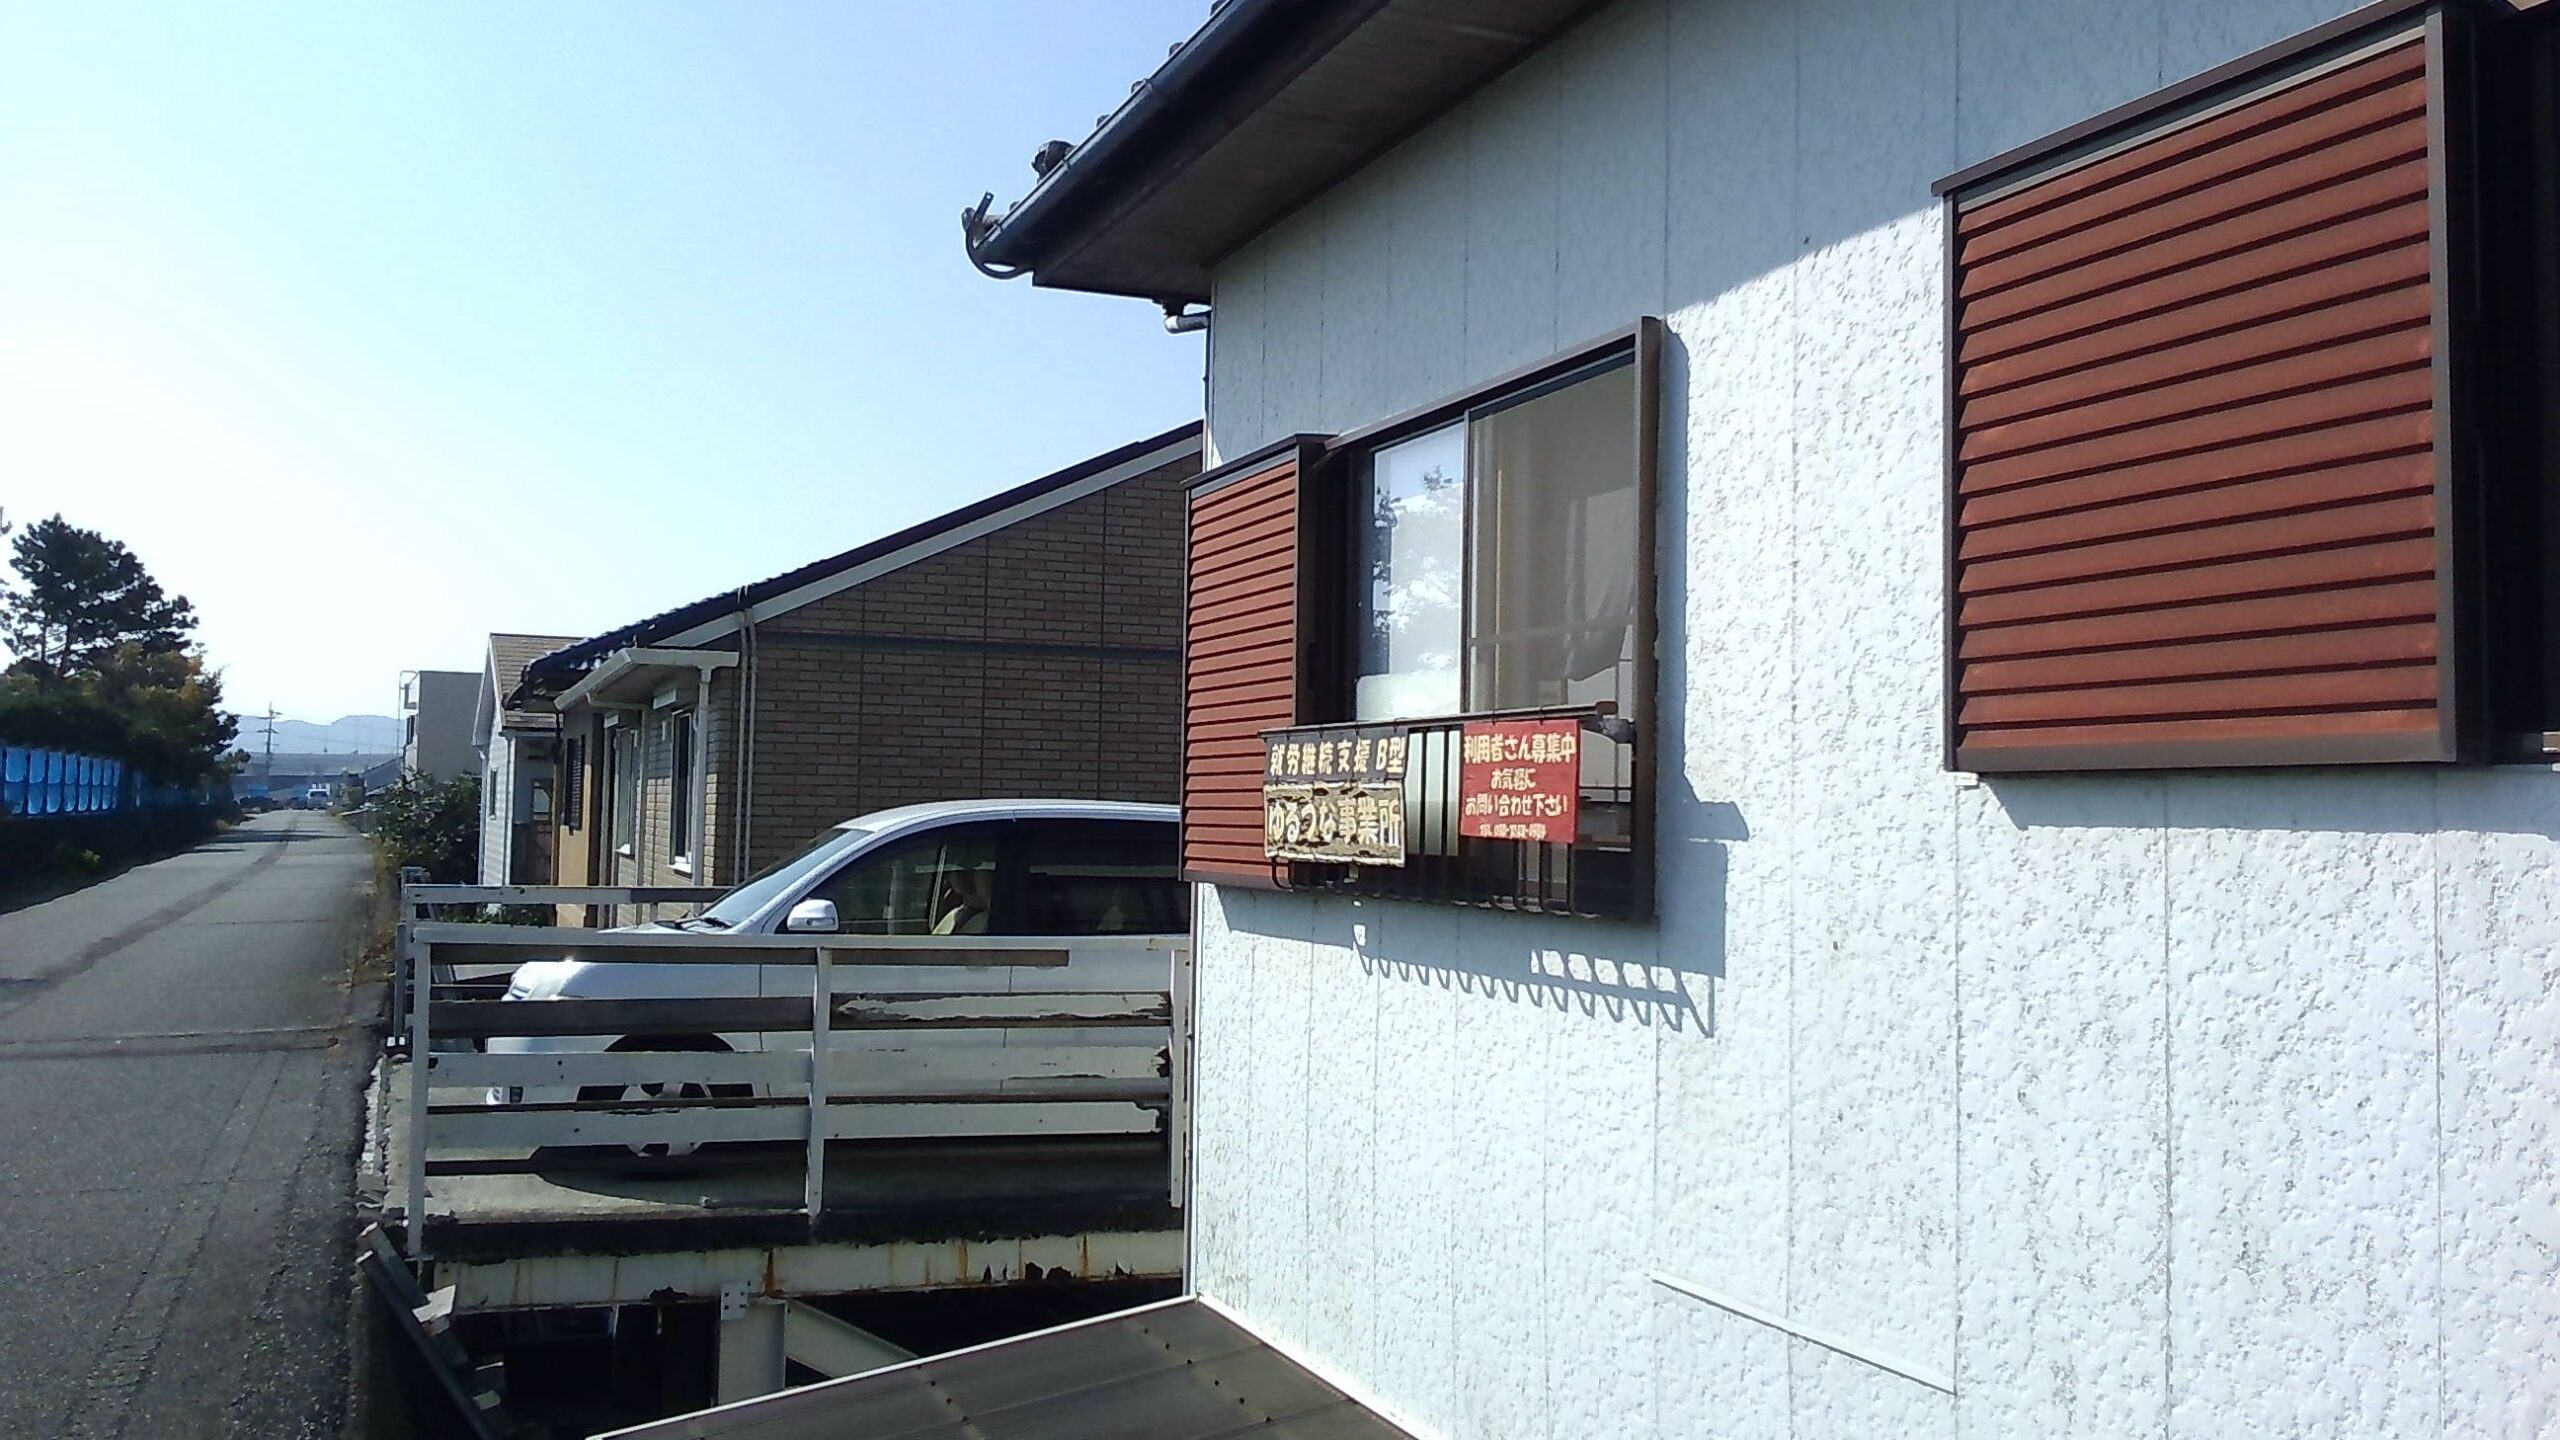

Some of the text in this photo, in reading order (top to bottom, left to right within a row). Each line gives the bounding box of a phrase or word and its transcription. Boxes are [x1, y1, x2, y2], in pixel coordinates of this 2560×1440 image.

[1463, 732, 1577, 765] 利用者さん募集中
[1491, 767, 1537, 791] お気軽に
[1465, 793, 1569, 818] お問い合わせ下さい
